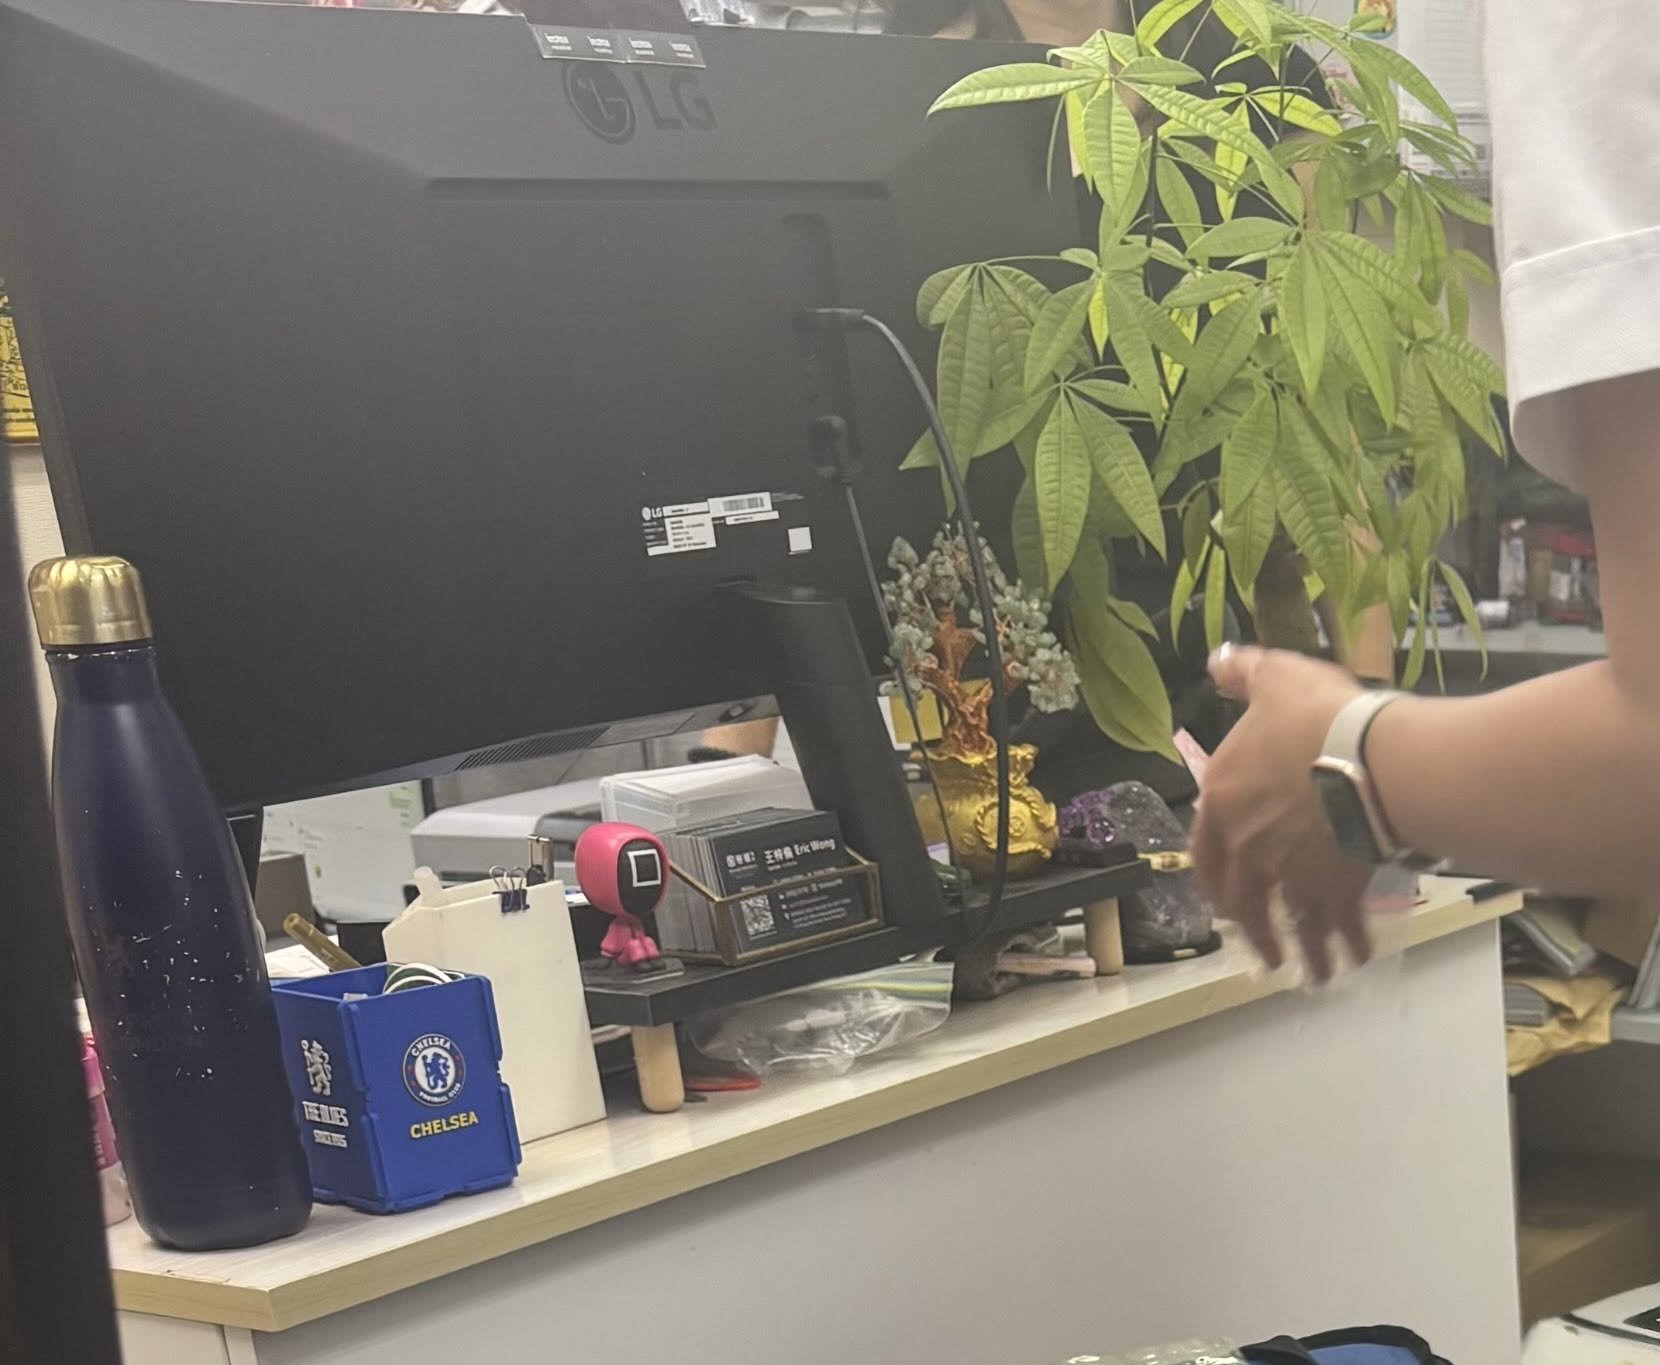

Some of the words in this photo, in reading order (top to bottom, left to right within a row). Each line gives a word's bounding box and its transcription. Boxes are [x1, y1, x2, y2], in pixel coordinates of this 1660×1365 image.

[632, 70, 718, 130] LG
[411, 1037, 451, 1057] CHELSEA
[410, 1111, 479, 1139] CHELSEA
